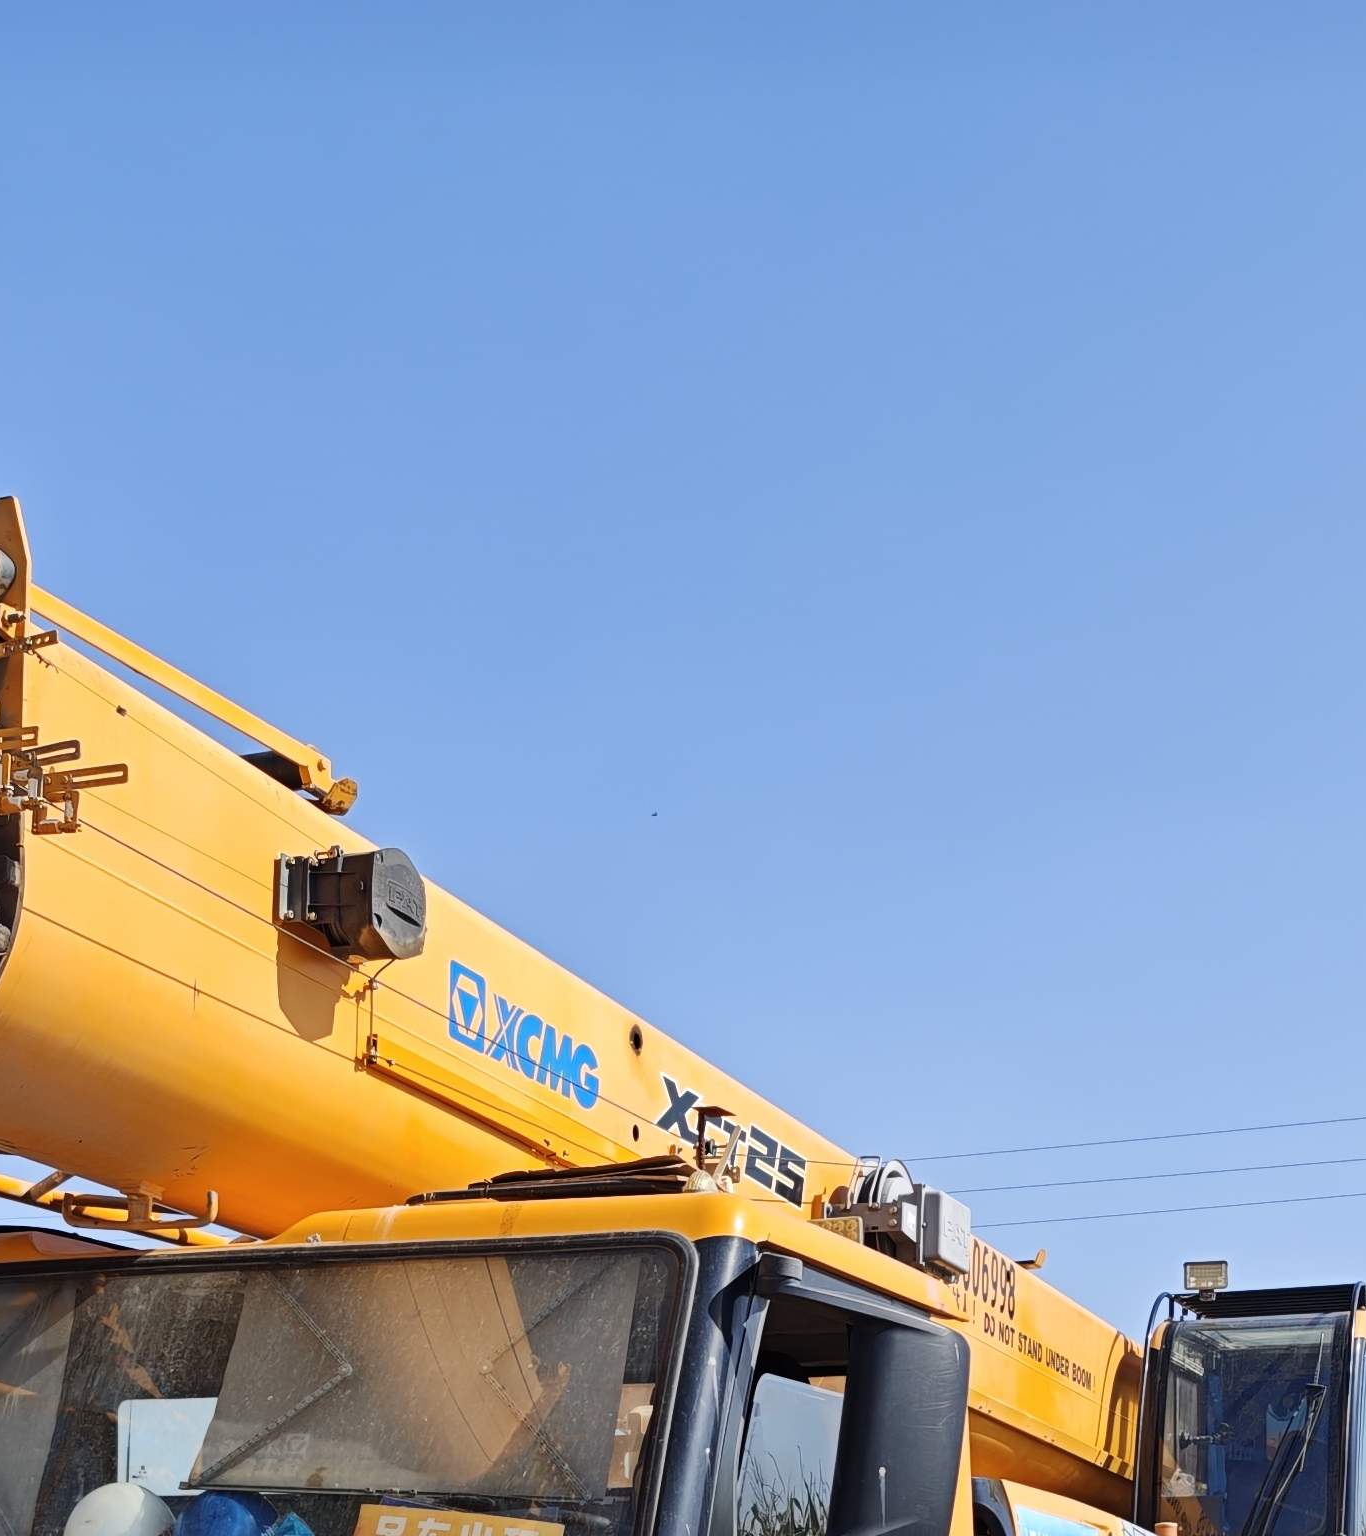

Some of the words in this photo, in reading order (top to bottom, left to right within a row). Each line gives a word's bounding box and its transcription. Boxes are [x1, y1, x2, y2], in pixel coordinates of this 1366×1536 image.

[486, 993, 600, 1110] XCMG
[999, 1320, 1016, 1349] NOT
[1018, 1331, 1043, 1363] STAND
[1046, 1346, 1070, 1379] UNDER
